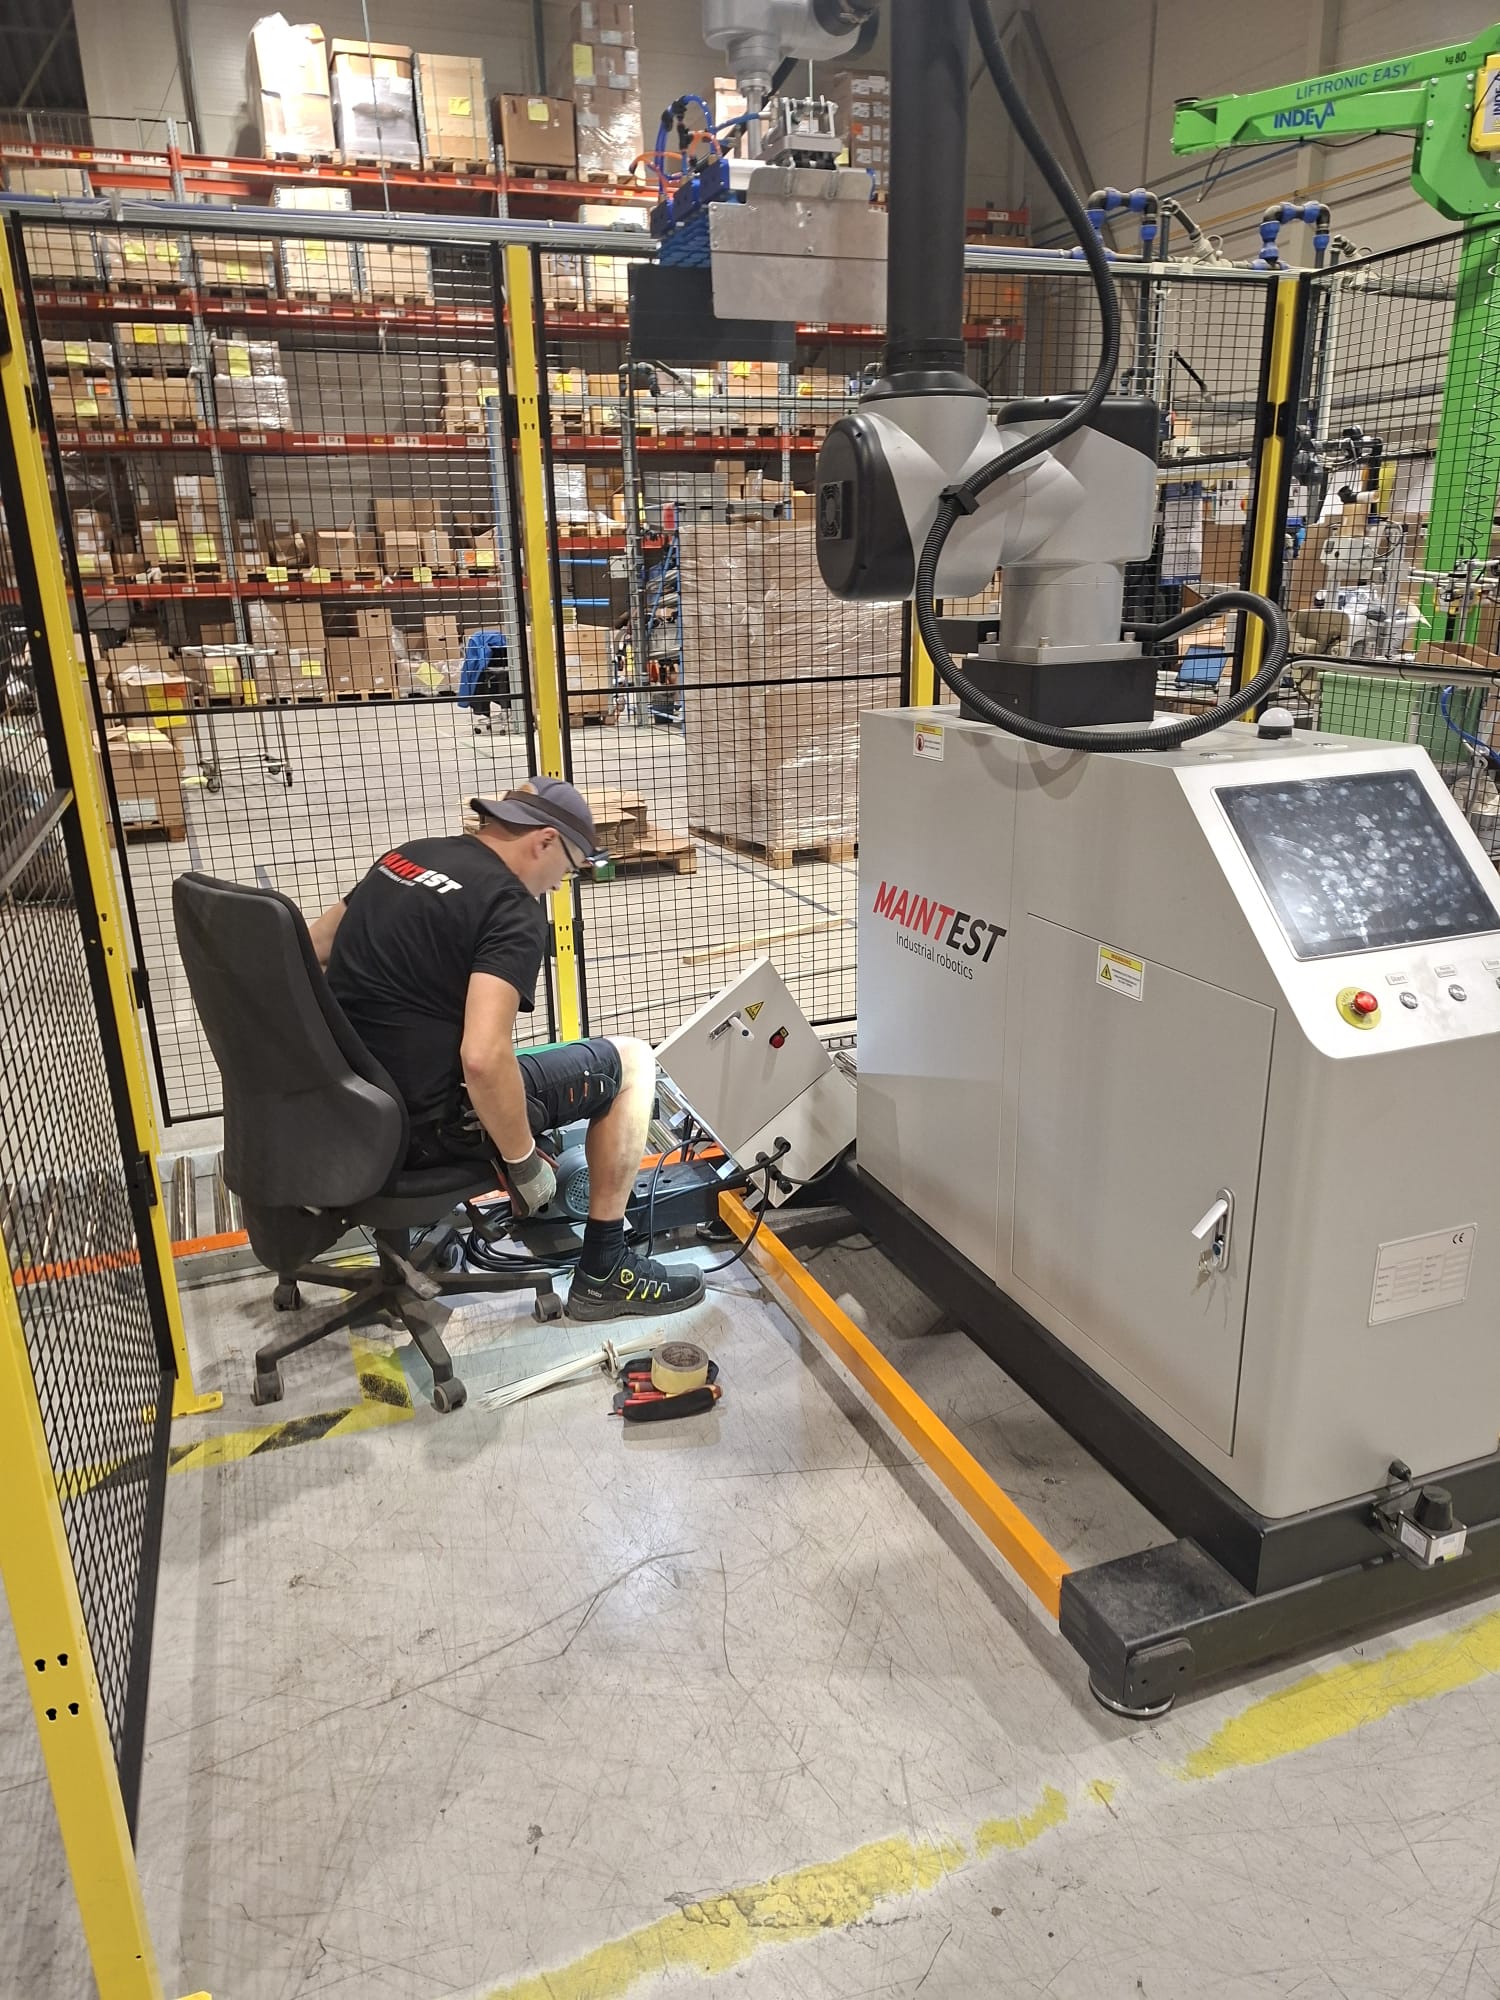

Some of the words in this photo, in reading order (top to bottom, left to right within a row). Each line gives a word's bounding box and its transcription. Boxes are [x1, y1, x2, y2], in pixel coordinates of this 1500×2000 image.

[1455, 51, 1467, 63] 80
[1296, 72, 1368, 100] LIFTRONIC
[1373, 61, 1412, 82] EASY
[1274, 100, 1335, 129] INDEVA
[873, 881, 1007, 963] MAINTEST
[896, 931, 935, 961] Industrial
[936, 953, 974, 980] robotics
